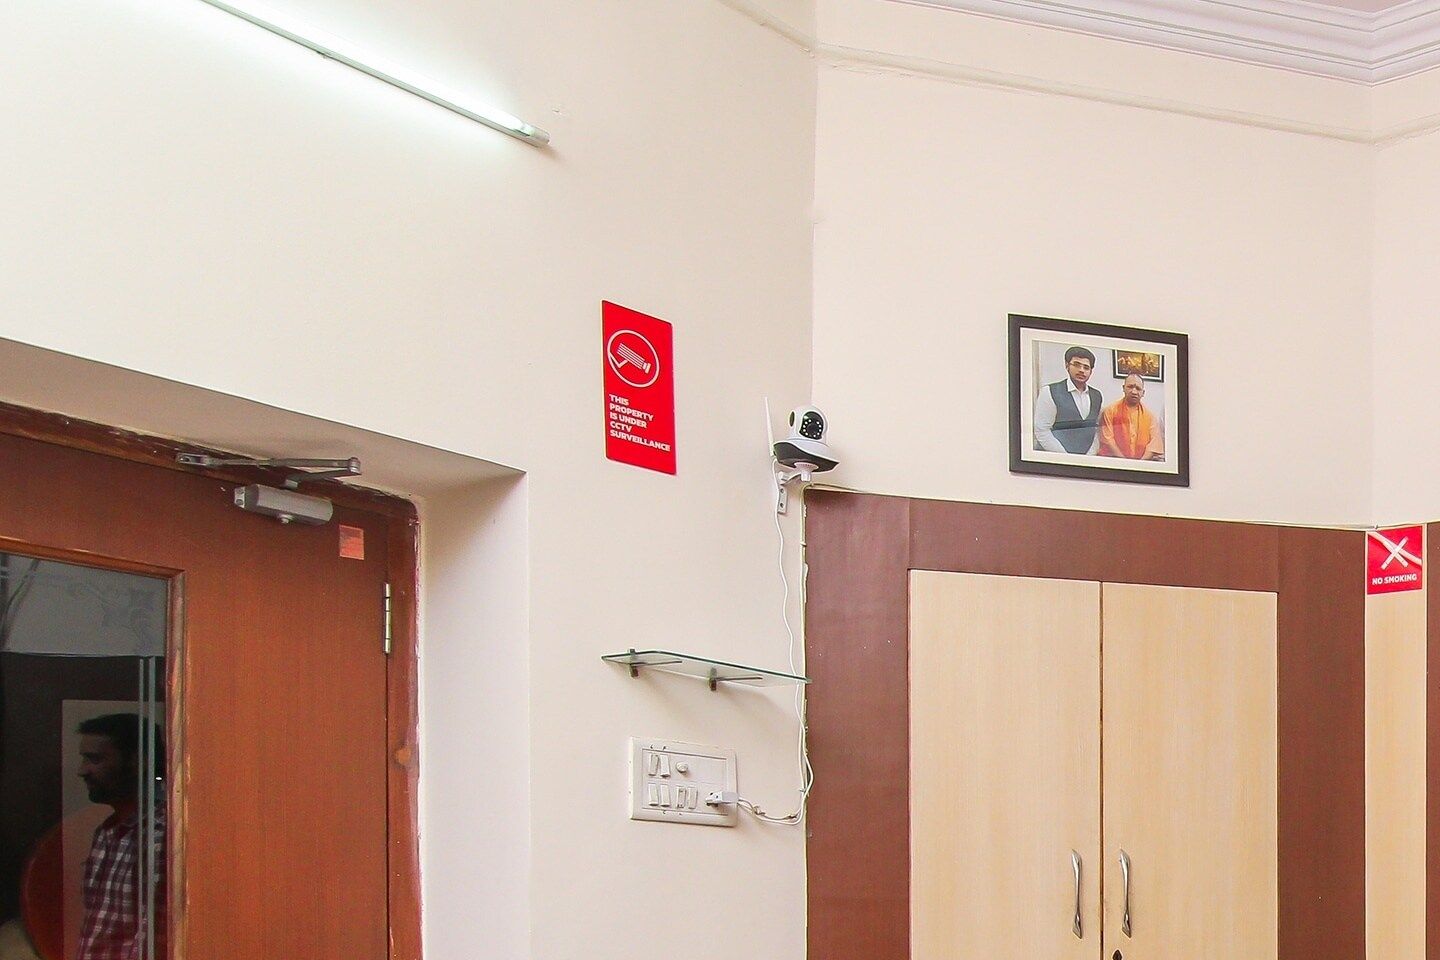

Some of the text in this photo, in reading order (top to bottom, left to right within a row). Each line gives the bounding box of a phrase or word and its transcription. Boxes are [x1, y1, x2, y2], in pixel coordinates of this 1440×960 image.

[609, 394, 629, 406] THIS
[609, 403, 654, 421] PROPERTY
[609, 412, 647, 428] IS UNDER
[610, 421, 632, 432] CCTV
[610, 430, 671, 451] SURVEILLANCE
[1372, 573, 1418, 585] NO SMOKING
